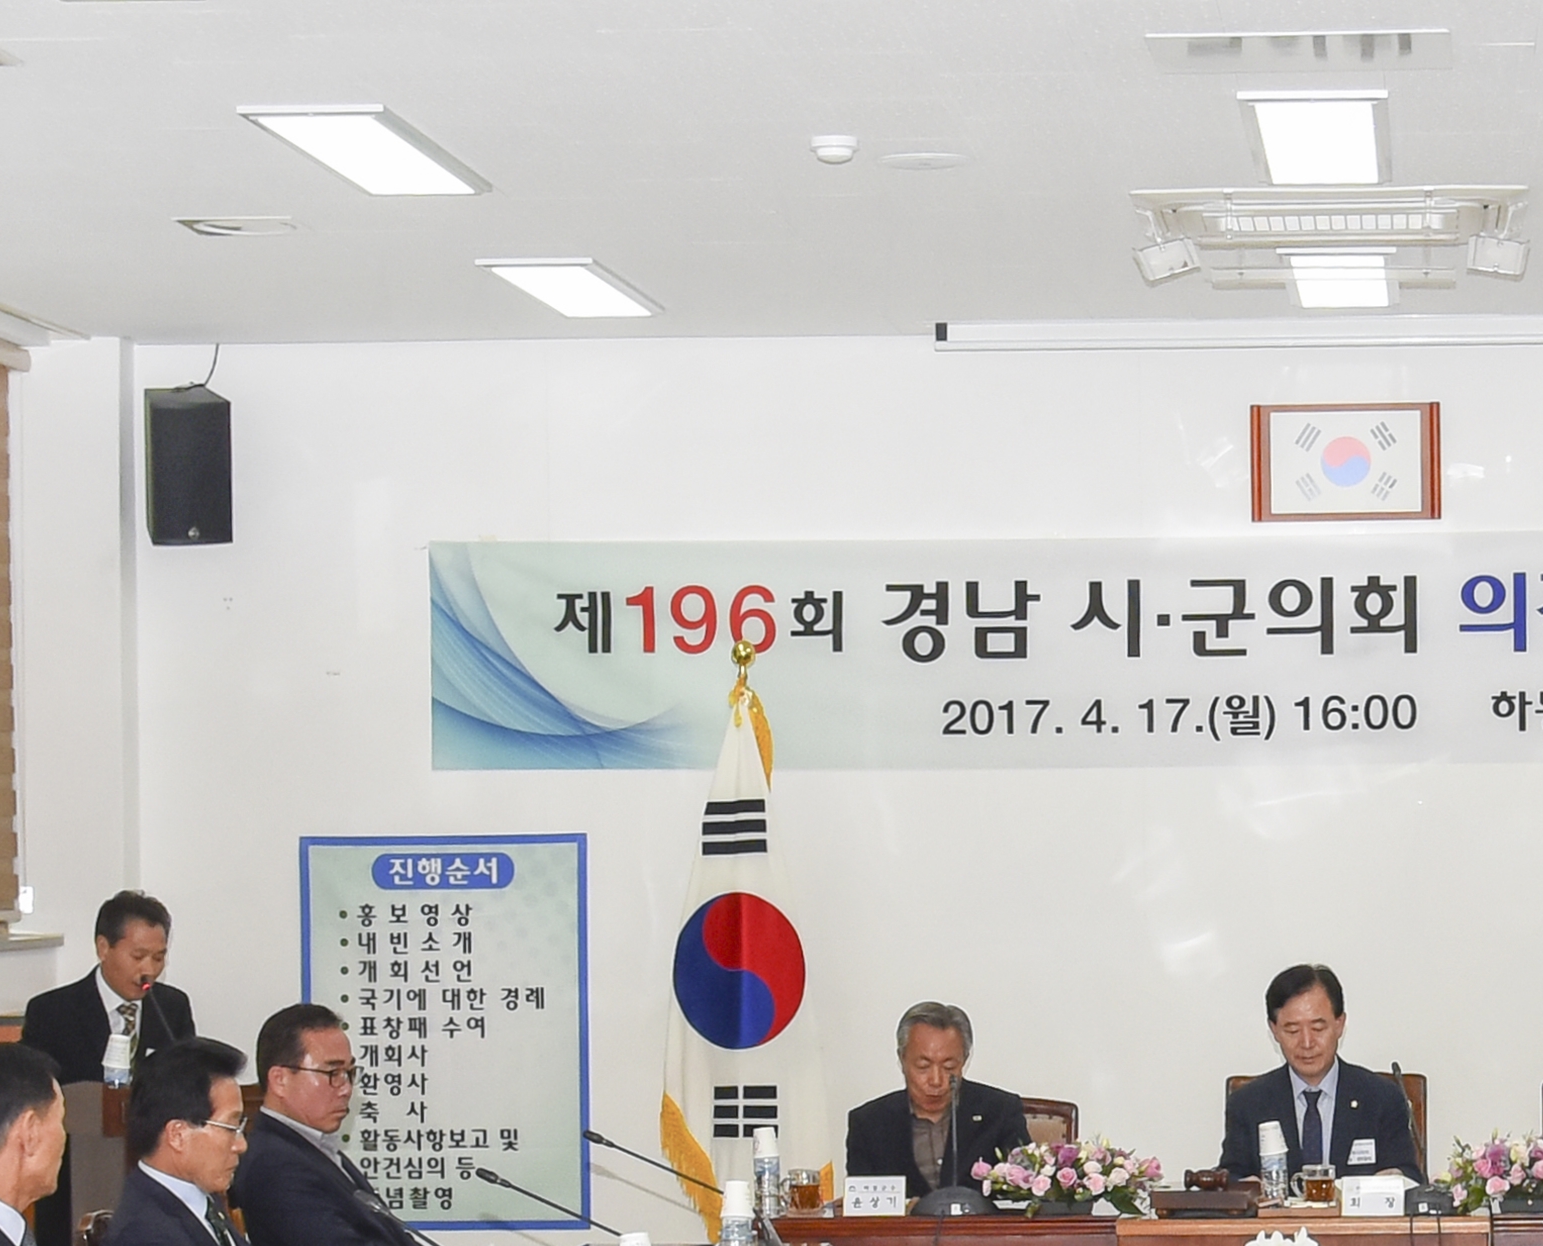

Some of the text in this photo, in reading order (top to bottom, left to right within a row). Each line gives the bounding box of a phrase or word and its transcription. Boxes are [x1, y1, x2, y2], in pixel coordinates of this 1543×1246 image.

[554, 585, 842, 661] 제196회
[882, 581, 1040, 662] 경남
[1071, 576, 1417, 657] 시·군의회
[943, 700, 1062, 735] 2017.
[1081, 700, 1118, 733] 4.
[1139, 695, 1275, 741] 17.(월)
[1295, 695, 1416, 730] 16:00
[389, 857, 499, 885] 진행순서
[359, 987, 544, 1010] 국기에 대한 경례
[360, 1017, 484, 1039] 표창패 수여
[359, 1045, 427, 1068] 개회사
[360, 1073, 428, 1096] 환영사
[361, 1129, 518, 1152] 활동사항보고 및
[360, 1156, 476, 1180] 안건심의 등
[374, 1186, 454, 1210] 념촬영
